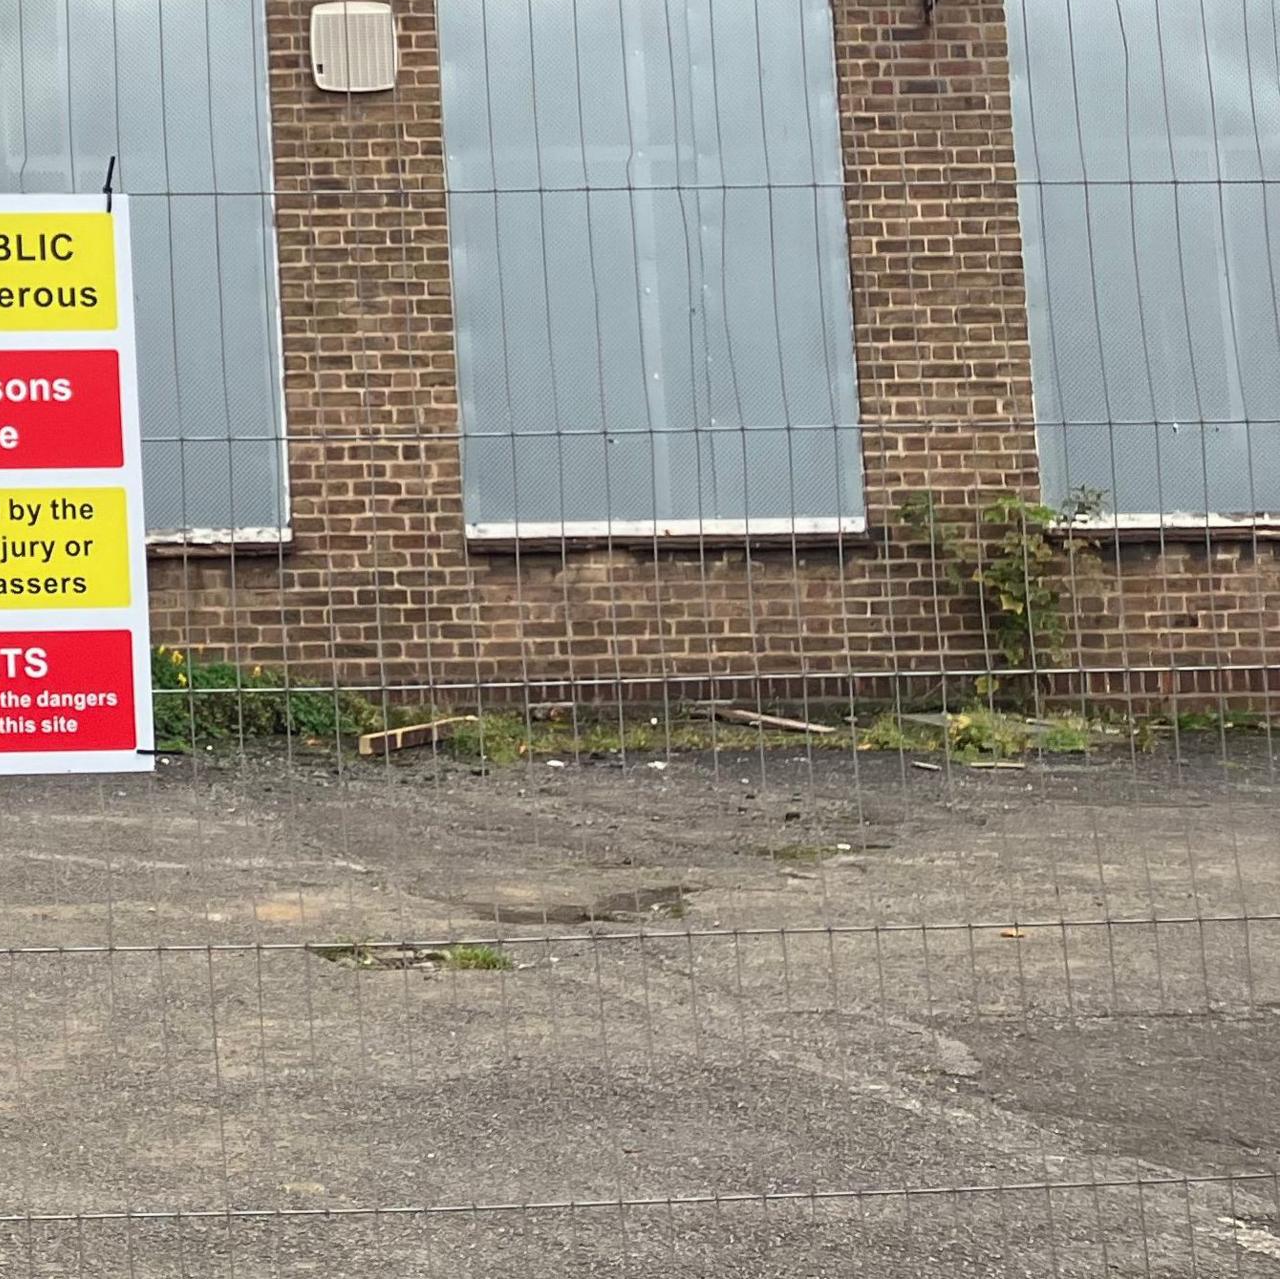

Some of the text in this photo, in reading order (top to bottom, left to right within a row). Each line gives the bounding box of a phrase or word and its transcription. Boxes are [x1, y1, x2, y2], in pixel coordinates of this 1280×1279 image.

[9, 498, 42, 527] by
[50, 498, 94, 520] the
[65, 540, 94, 557] or
[0, 690, 32, 708] the
[36, 690, 118, 711] dangers
[41, 715, 78, 733] site
